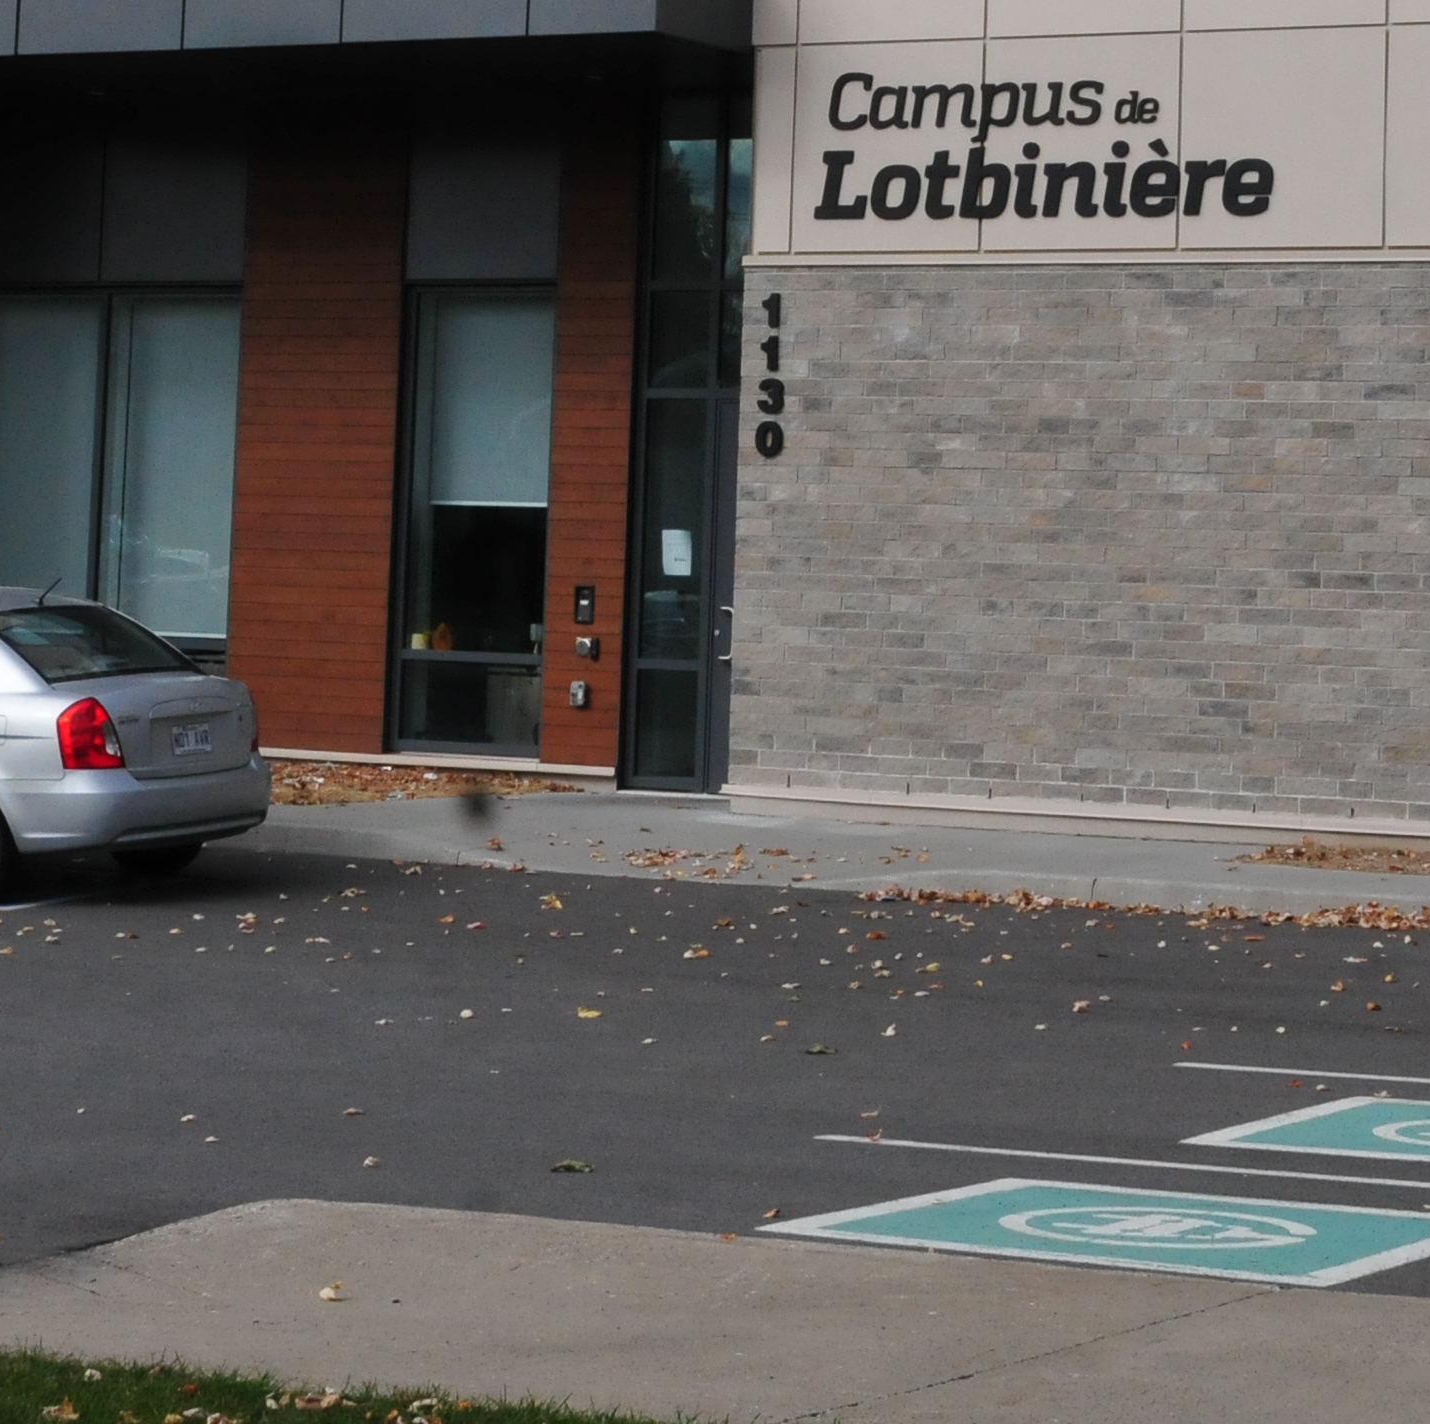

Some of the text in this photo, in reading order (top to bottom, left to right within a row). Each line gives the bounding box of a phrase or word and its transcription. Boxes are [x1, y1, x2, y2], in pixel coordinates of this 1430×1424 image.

[828, 72, 1160, 143] Campus de
[813, 138, 1274, 221] Lotbinière
[754, 293, 785, 459] 1130
